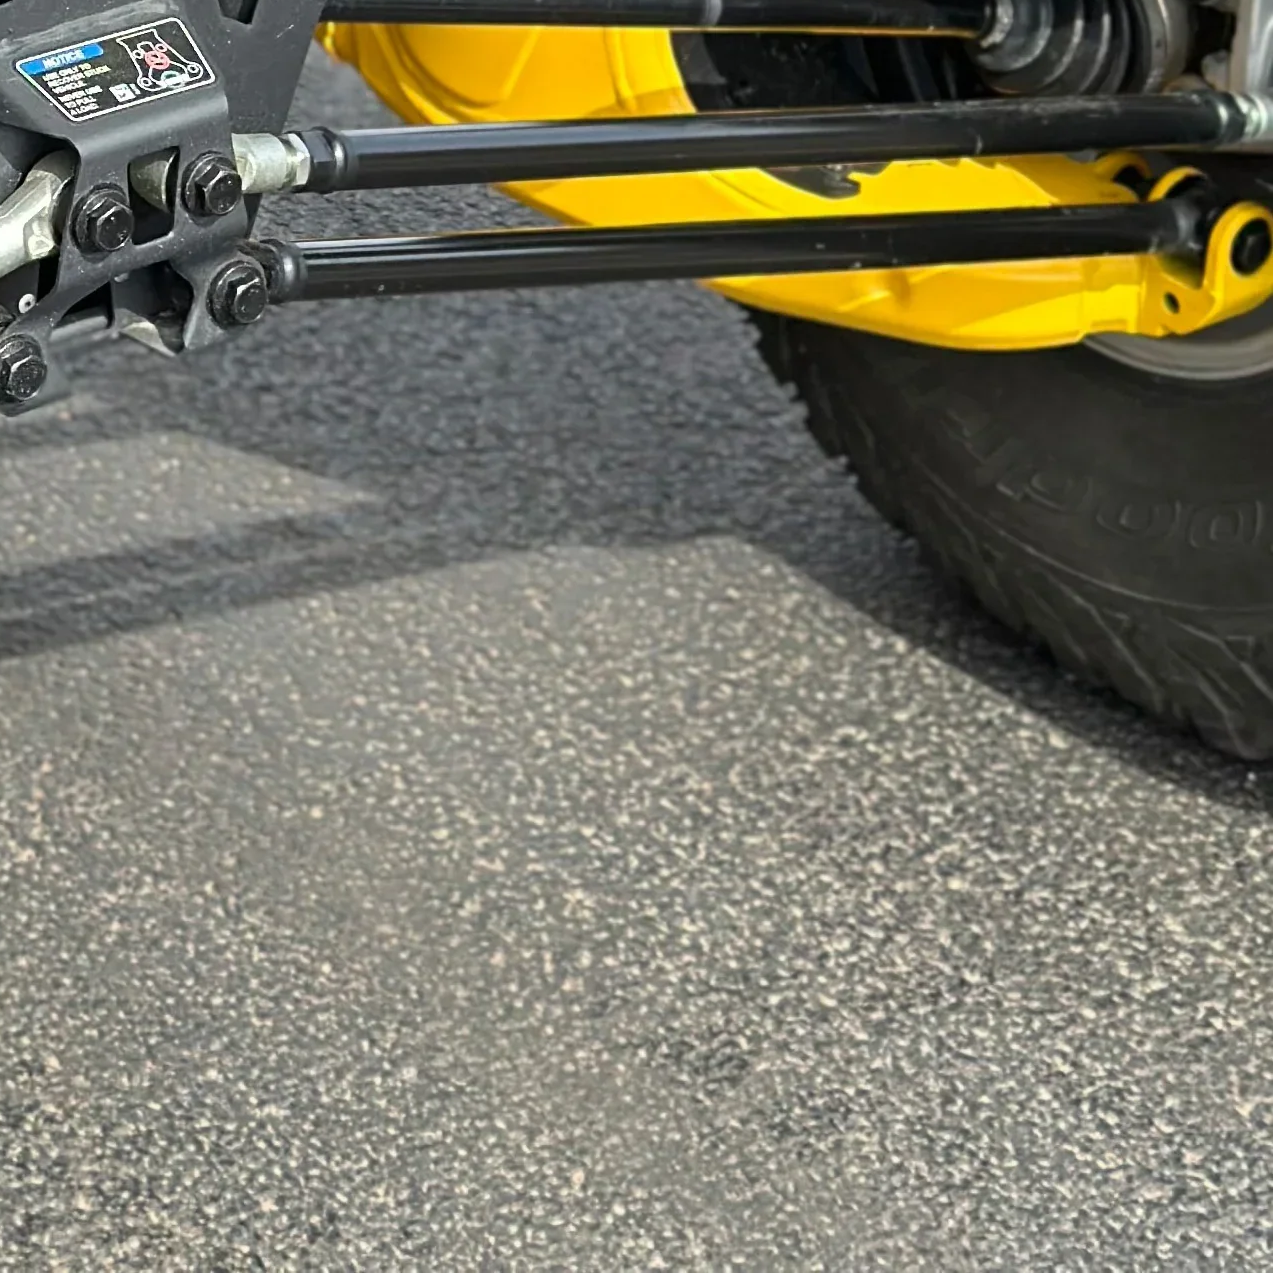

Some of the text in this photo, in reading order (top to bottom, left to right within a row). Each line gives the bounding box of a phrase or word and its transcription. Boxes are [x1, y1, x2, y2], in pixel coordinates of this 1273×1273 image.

[41, 49, 85, 69] NOTICE
[58, 66, 79, 76] ONLY
[83, 64, 111, 77] STUCK
